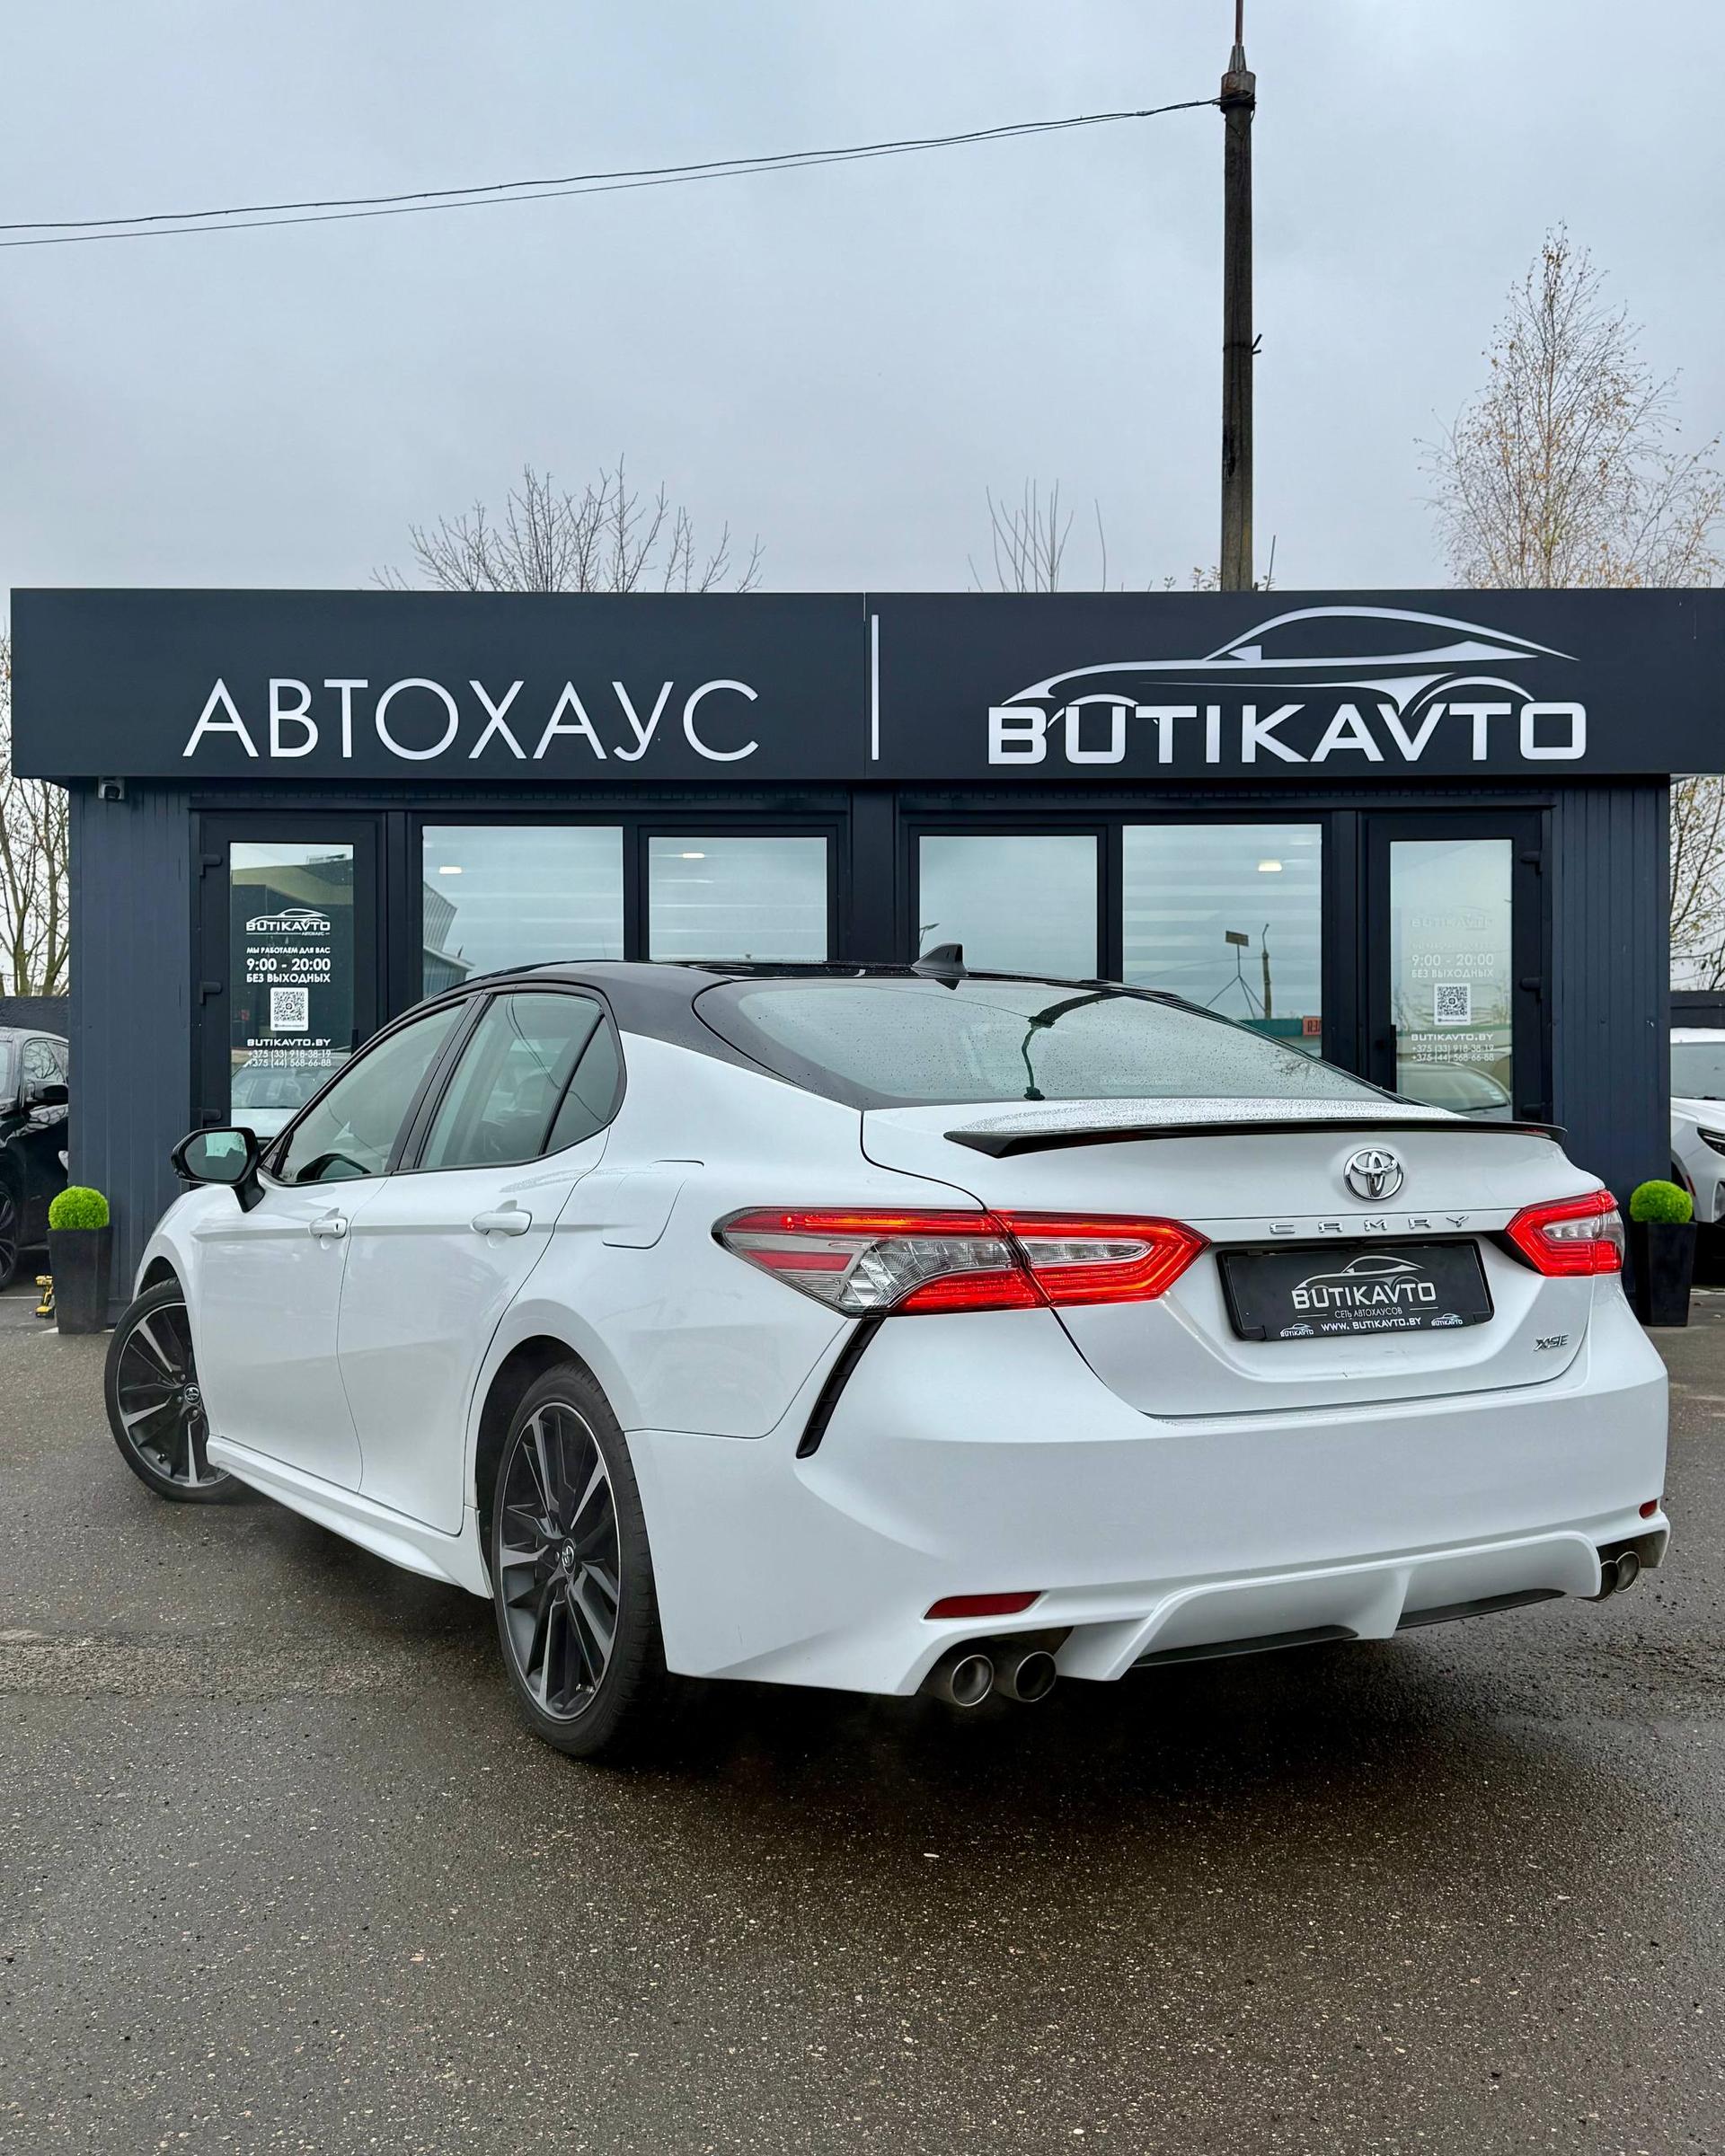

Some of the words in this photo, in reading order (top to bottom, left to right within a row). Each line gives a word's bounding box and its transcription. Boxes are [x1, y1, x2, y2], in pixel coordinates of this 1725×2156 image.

[182, 677, 760, 761] АВТОХАУС
[988, 702, 1587, 764] BUTIKAVTO
[246, 922, 331, 931] BUTIKAVTO
[246, 958, 277, 971] 9:00
[291, 958, 331, 971] 20:00
[1411, 954, 1441, 967] 9:00
[1456, 953, 1494, 966] 20:00
[246, 973, 264, 983] БЕЗ
[267, 973, 331, 984] ВЫХОДНЫХ
[1411, 969, 1429, 978] БЕЗ
[1431, 969, 1494, 978] ВЫХОДНЫХ
[247, 1038, 331, 1047] BUTIKAVTO.BY
[1412, 1044, 1432, 1052] +375
[248, 1049, 269, 1058] +375
[271, 1049, 288, 1059] (33)
[289, 1049, 332, 1058] 918-38-19
[248, 1059, 269, 1067] +375
[271, 1058, 288, 1068] (44)
[289, 1059, 332, 1067] 568-66-88
[1269, 1215, 1470, 1235] CAMRY
[1291, 1282, 1437, 1310] BUTIKAVTO
[1334, 1310, 1352, 1320] СЕТЬ
[1353, 1306, 1403, 1319] АВТОХАУСОВ
[1321, 1321, 1350, 1331] WWW.
[1353, 1317, 1421, 1330] BUTIKAVTO.BY
[1279, 1329, 1314, 1338] BUTIKAVTO
[1534, 1334, 1569, 1351] XSE
